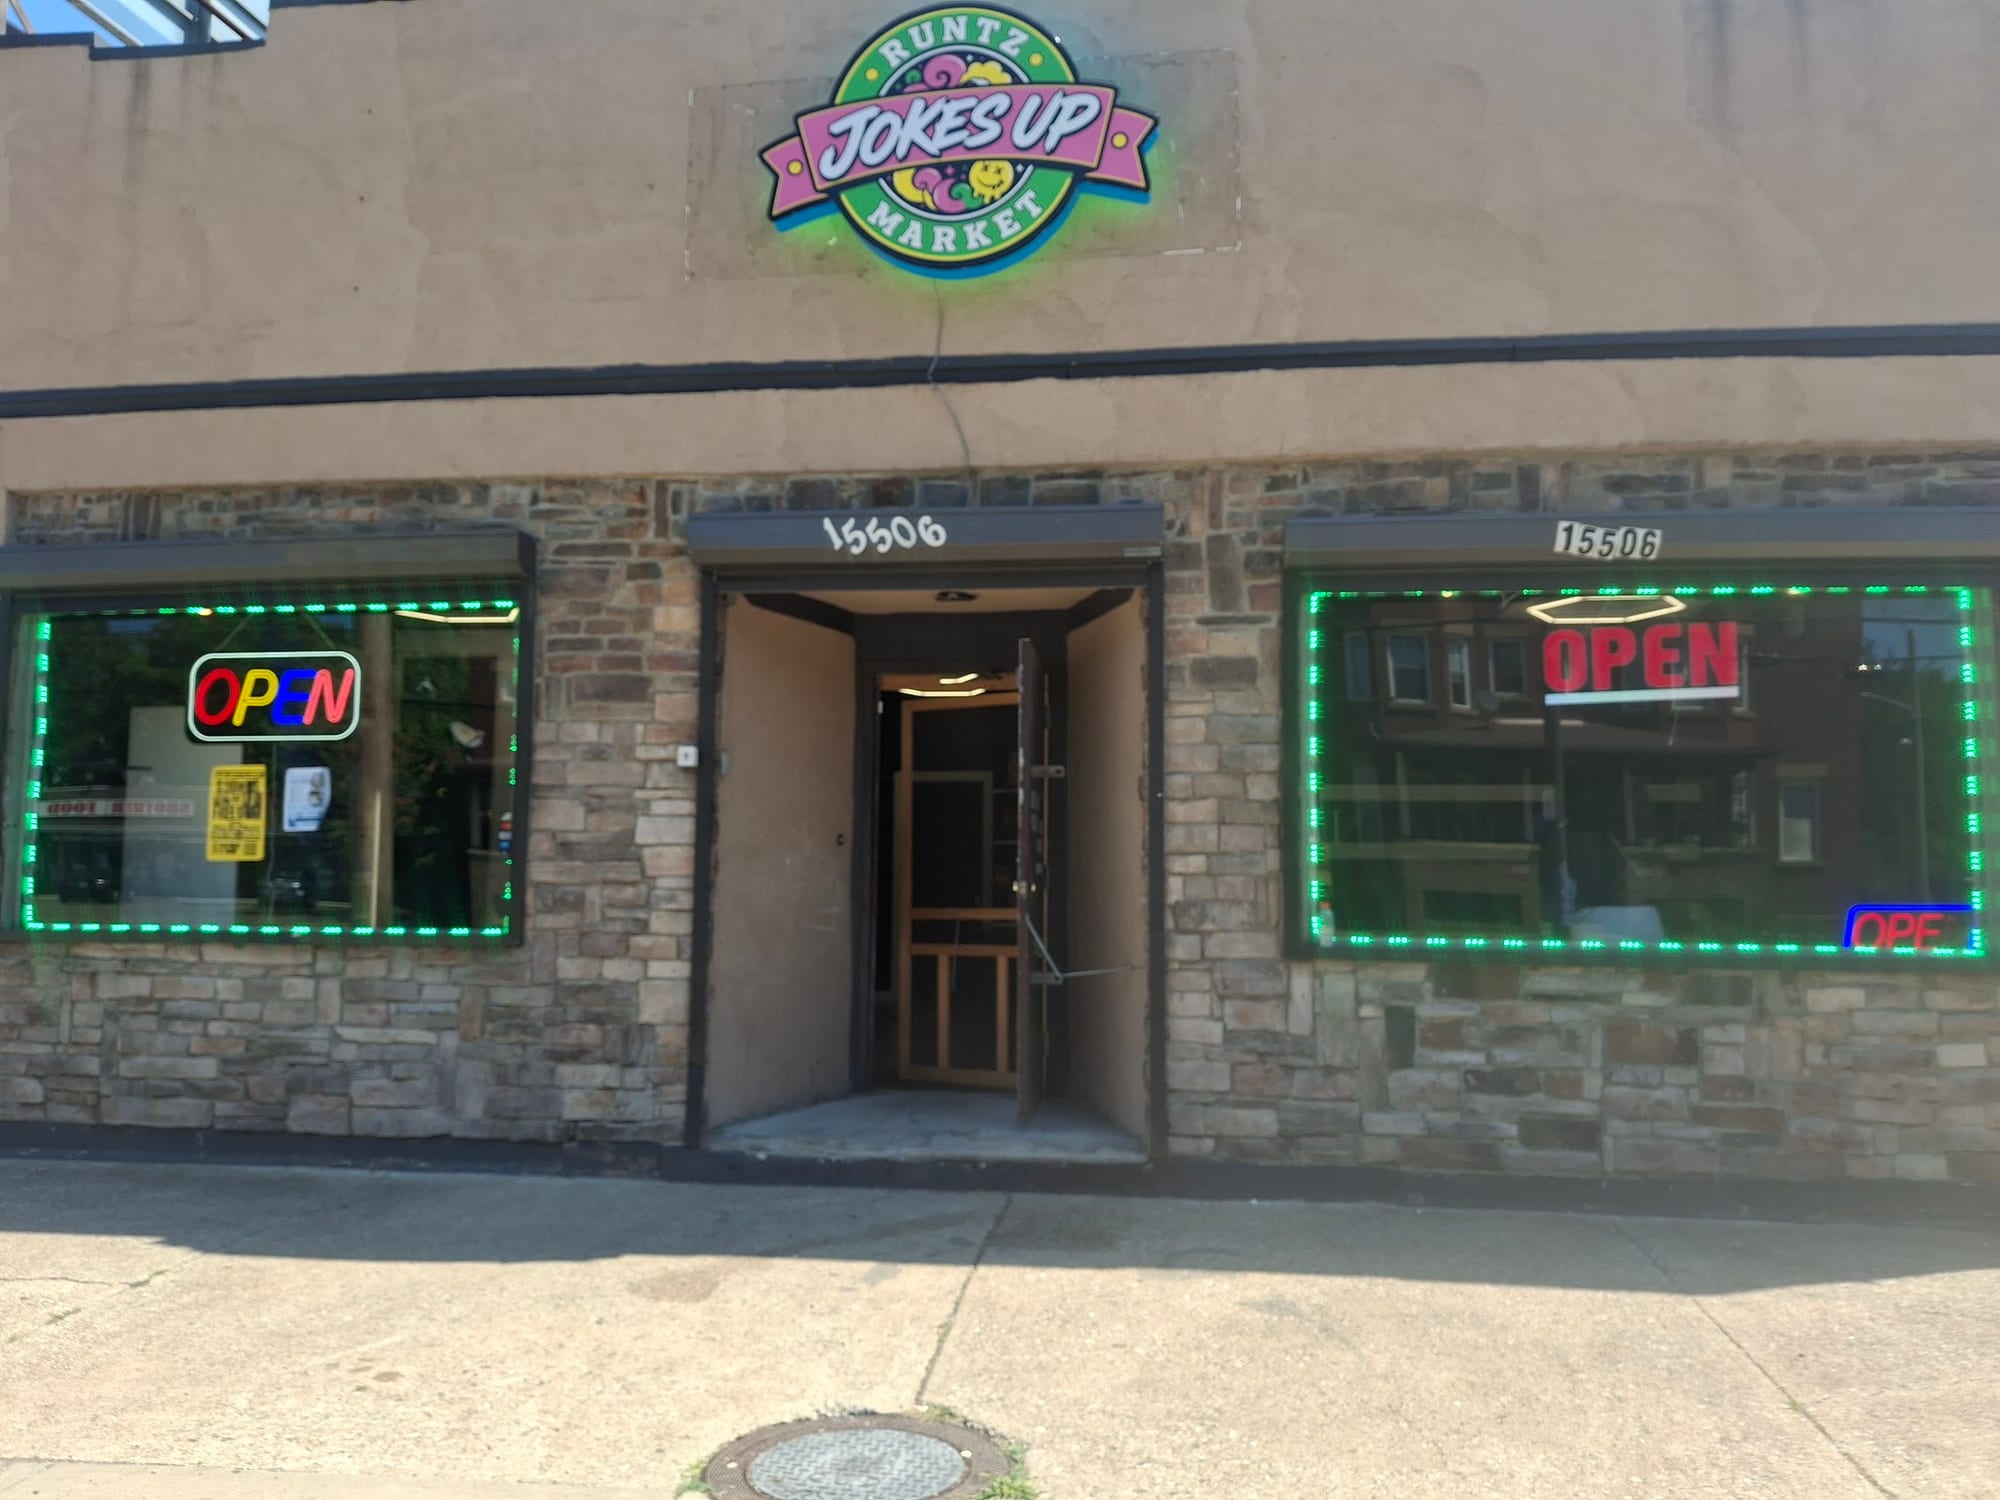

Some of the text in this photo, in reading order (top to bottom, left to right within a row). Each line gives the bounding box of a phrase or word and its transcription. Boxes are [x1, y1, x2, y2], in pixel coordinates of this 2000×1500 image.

[879, 15, 1028, 69] RUNTZ
[818, 89, 1101, 181] JOKES UP
[866, 190, 1043, 252] MARKET
[822, 514, 948, 556] 15506
[1561, 523, 1657, 558] 15506
[1543, 621, 1740, 693] OPEN
[194, 668, 354, 727] OPEN
